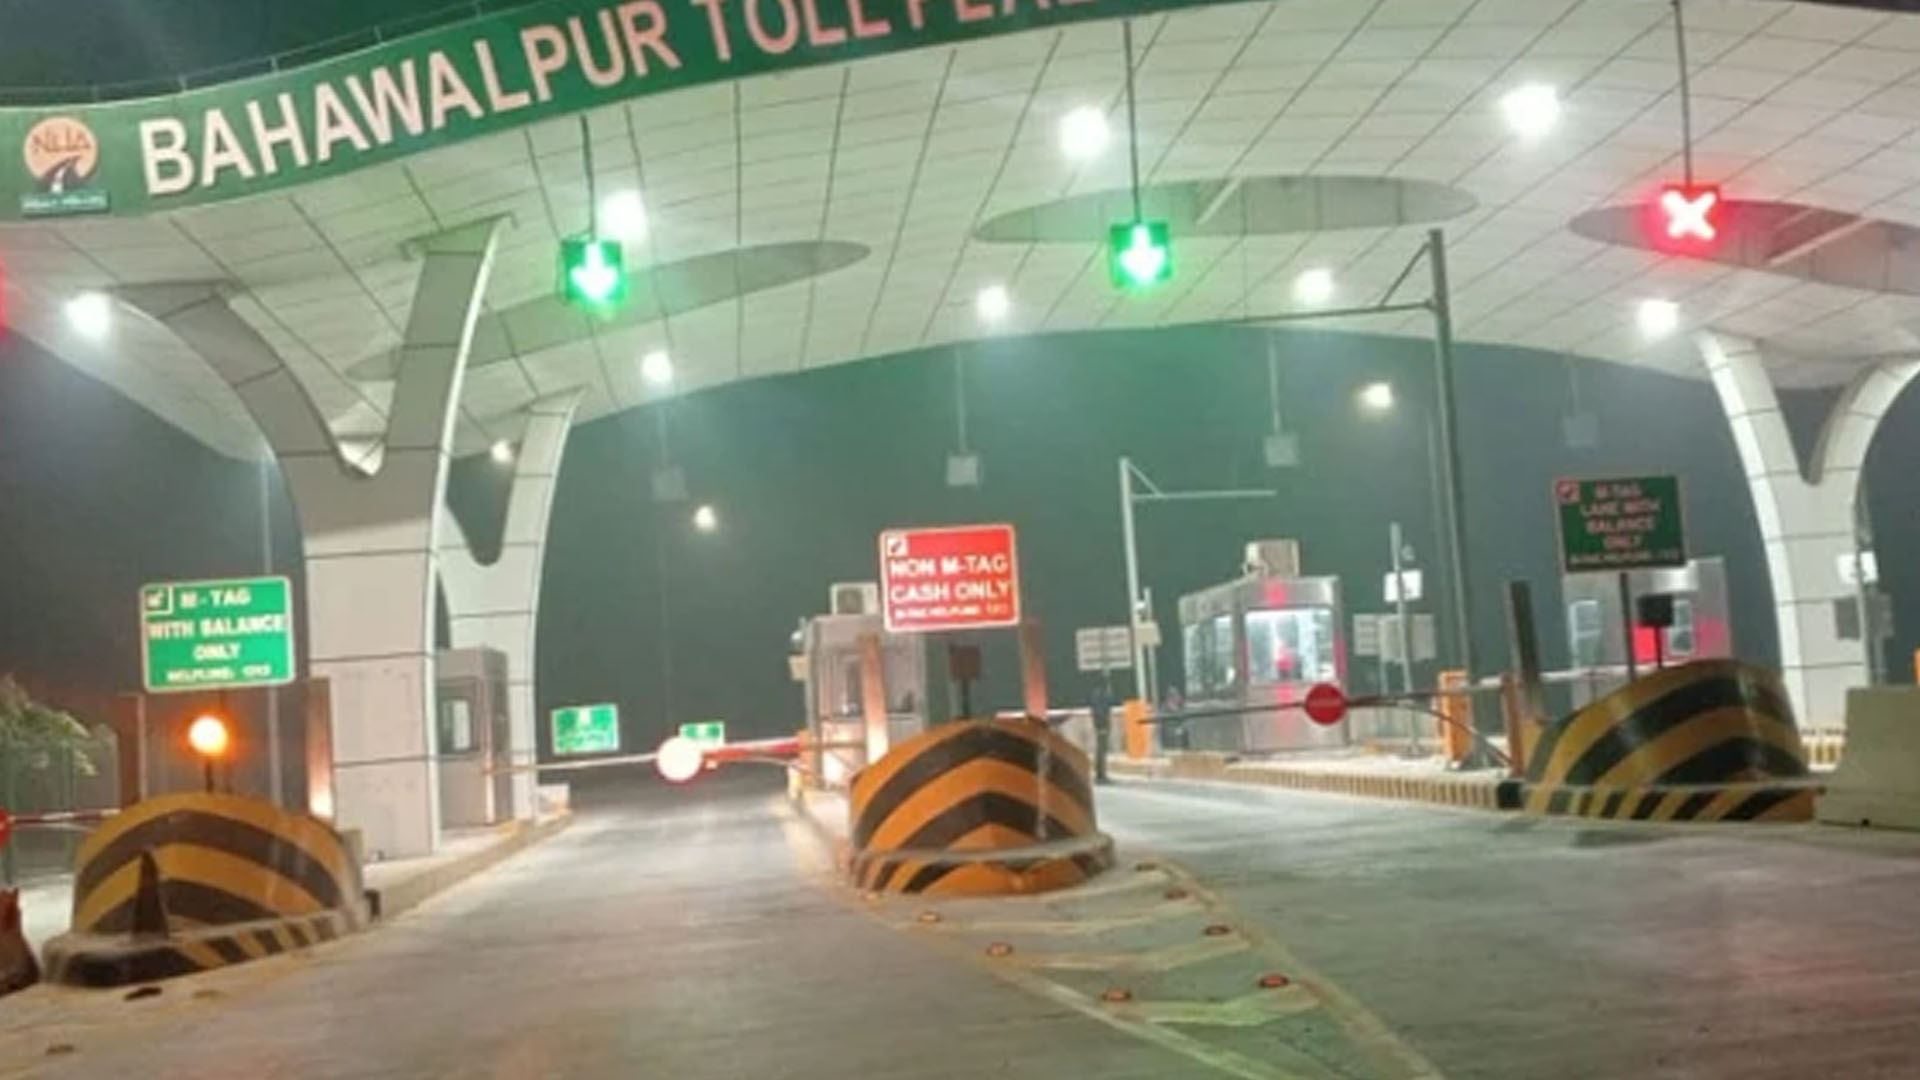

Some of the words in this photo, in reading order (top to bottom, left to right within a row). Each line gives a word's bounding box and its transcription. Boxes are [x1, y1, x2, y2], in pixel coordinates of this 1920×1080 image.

[138, 0, 681, 197] BAHAWALPUR
[690, 0, 891, 61] TOLL
[889, 557, 937, 578] NON
[940, 553, 1009, 577] M-TAG
[890, 581, 950, 604] CASH
[954, 578, 1010, 601] ONLY
[148, 619, 195, 640] WITH
[200, 613, 285, 638] BALANCE
[192, 642, 242, 662] ONLY
